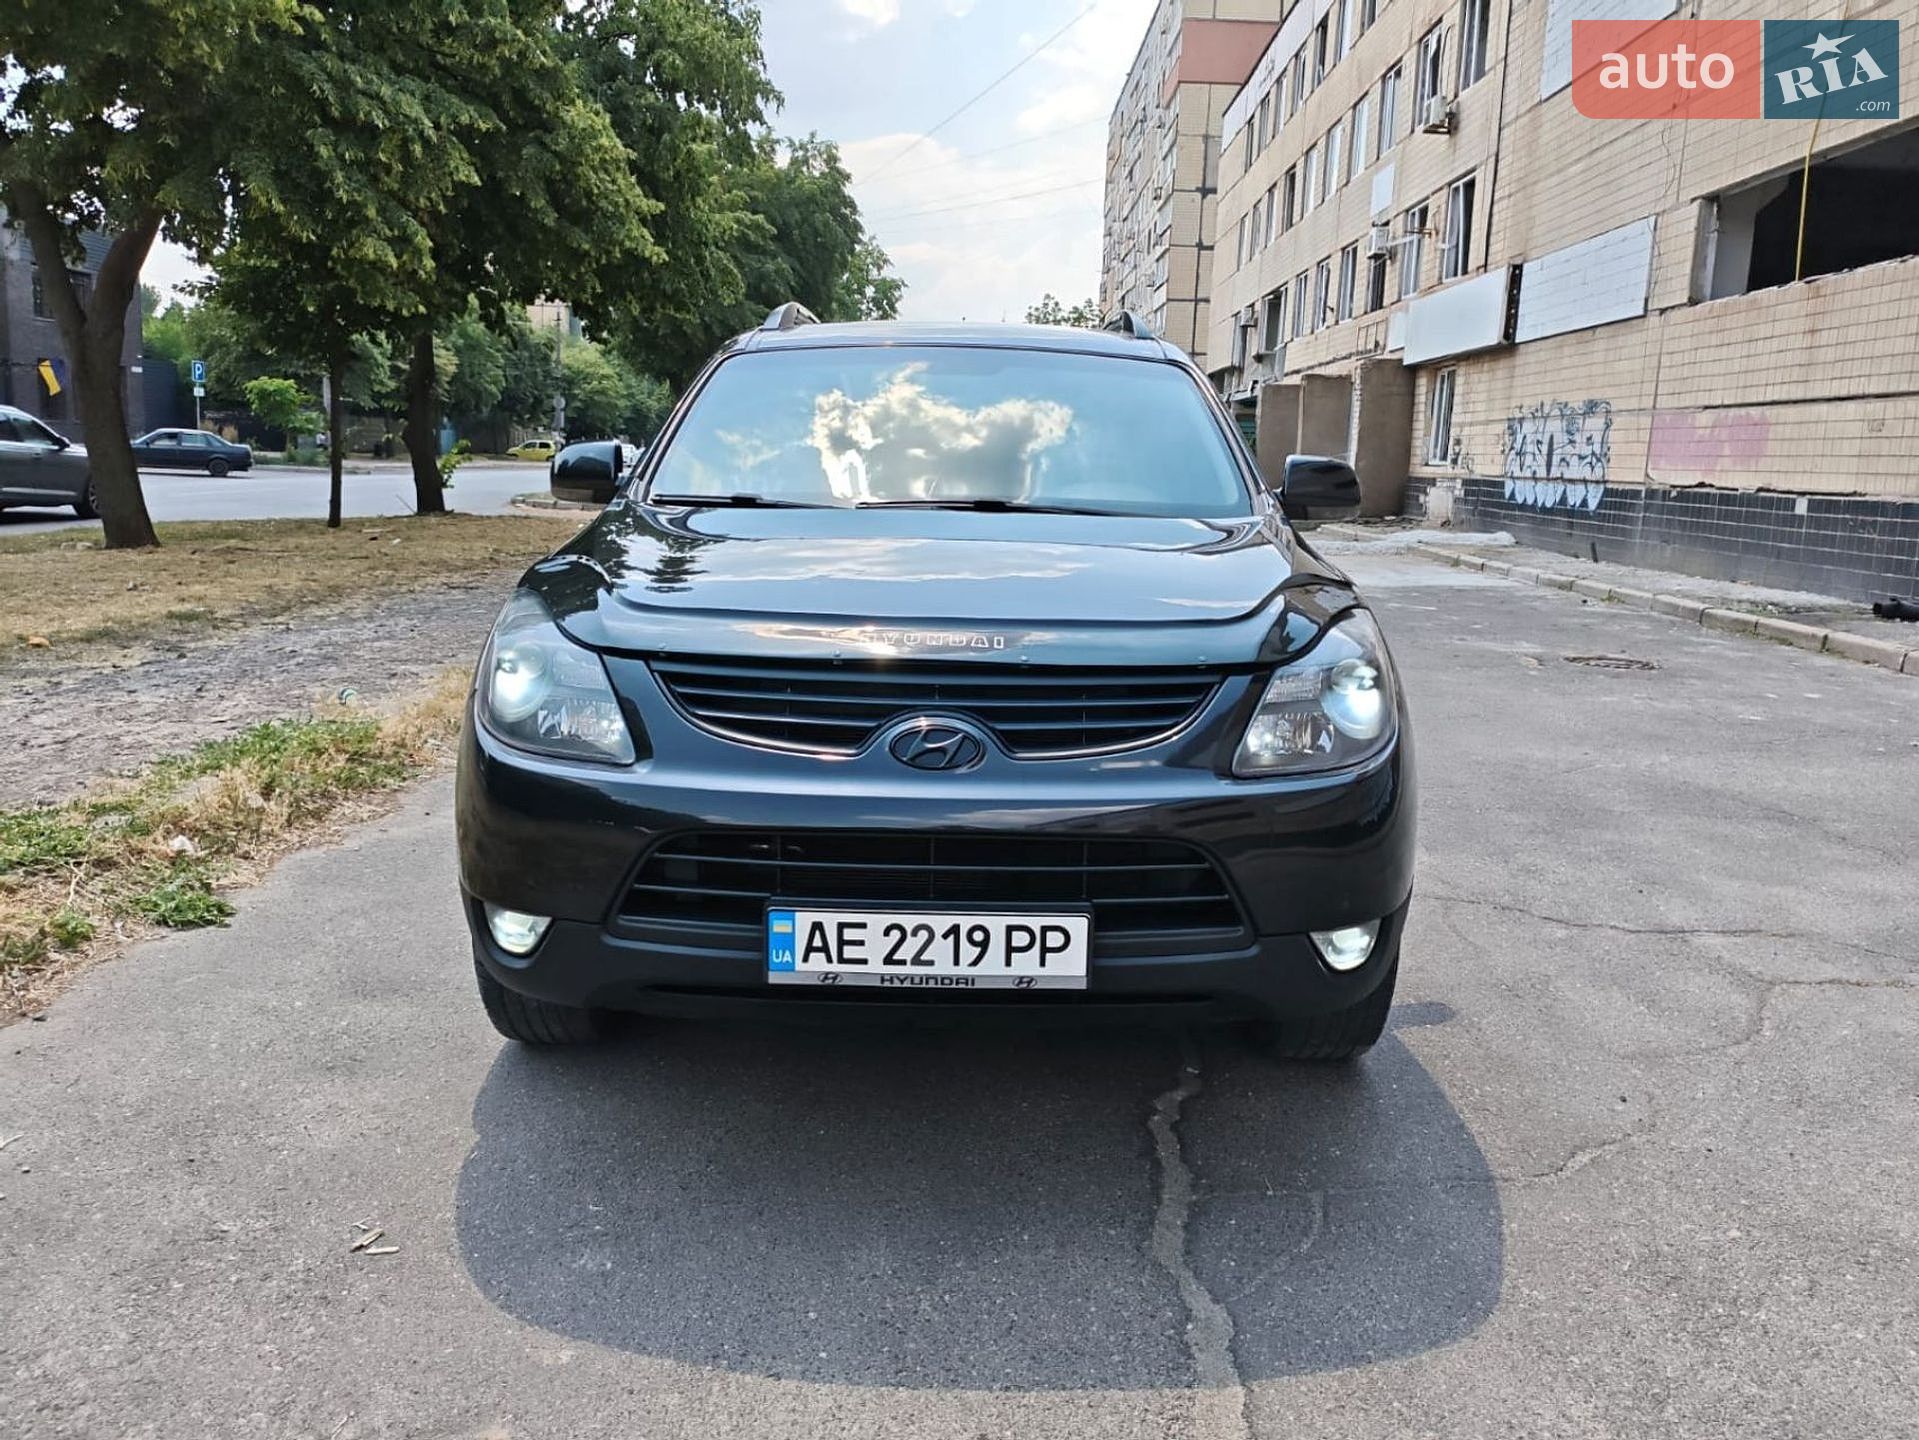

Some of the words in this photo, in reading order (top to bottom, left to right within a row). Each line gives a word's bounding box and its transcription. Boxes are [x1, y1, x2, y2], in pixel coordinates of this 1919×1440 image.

[194, 362, 203, 380] P
[801, 921, 869, 965] AE
[882, 923, 991, 967] 2219
[1004, 924, 1072, 968] PP
[772, 950, 793, 964] UA
[880, 975, 976, 988] HYUNDAI
